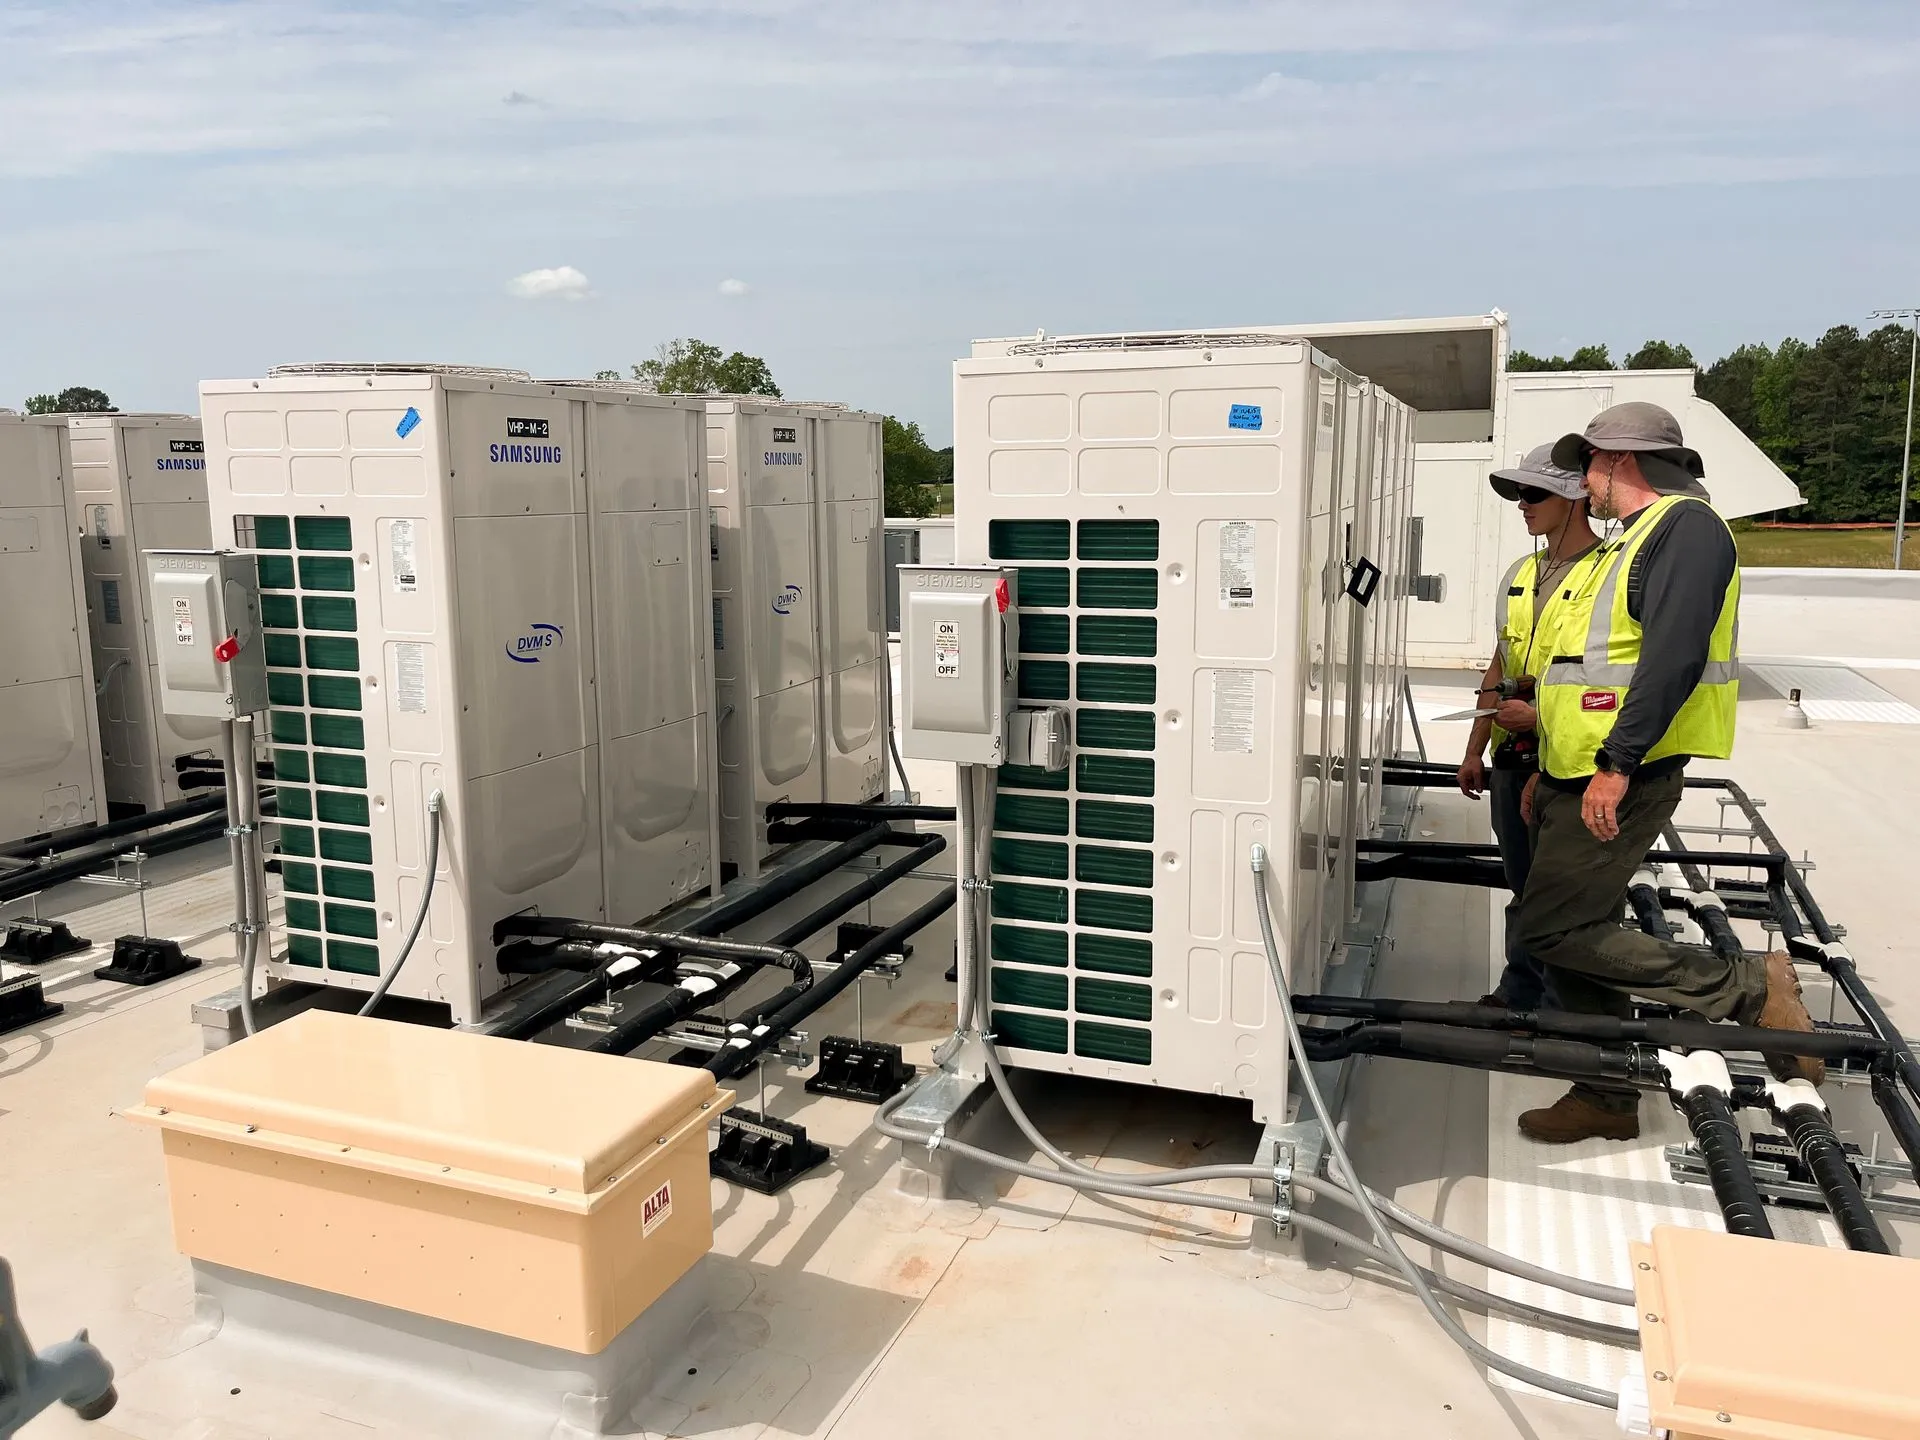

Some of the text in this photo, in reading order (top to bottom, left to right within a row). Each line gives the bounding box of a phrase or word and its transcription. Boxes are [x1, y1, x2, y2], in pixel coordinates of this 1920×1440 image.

[508, 421, 548, 435] VHP-M-2
[171, 442, 203, 451] VHP-L-1
[490, 444, 561, 463] SAMSUNG
[764, 451, 803, 466] SAMSUNG
[156, 458, 207, 470] SAMSUN
[159, 558, 207, 570] SIEMENS
[916, 574, 983, 589] SIEMENS
[176, 600, 187, 608] ON
[778, 593, 792, 604] DVM
[940, 624, 954, 633] ON
[518, 635, 544, 650] DVM
[545, 633, 553, 647] S
[938, 666, 956, 674] OFF
[644, 1185, 669, 1225] ALTA
